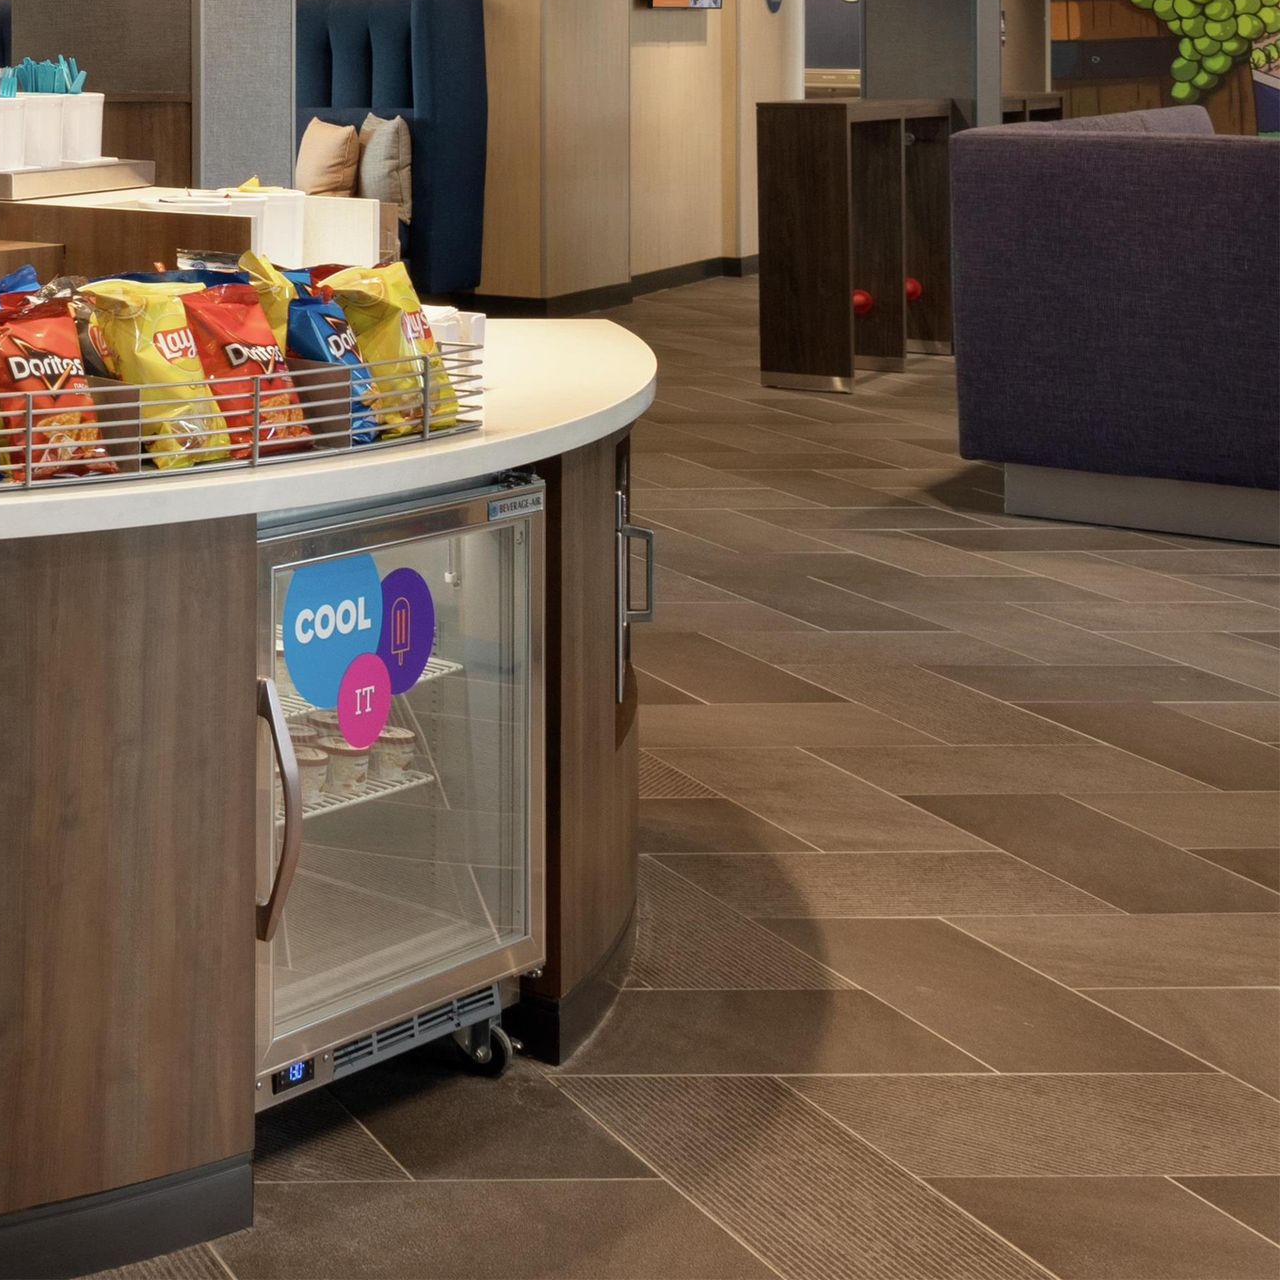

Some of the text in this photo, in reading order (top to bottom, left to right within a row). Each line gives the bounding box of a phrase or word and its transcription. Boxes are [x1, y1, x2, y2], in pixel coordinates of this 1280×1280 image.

[225, 342, 284, 367] Doritos
[8, 355, 85, 381] Doritos
[499, 496, 542, 513] BEVERAGE-AIR
[295, 596, 372, 645] COOL
[354, 685, 376, 718] IT
